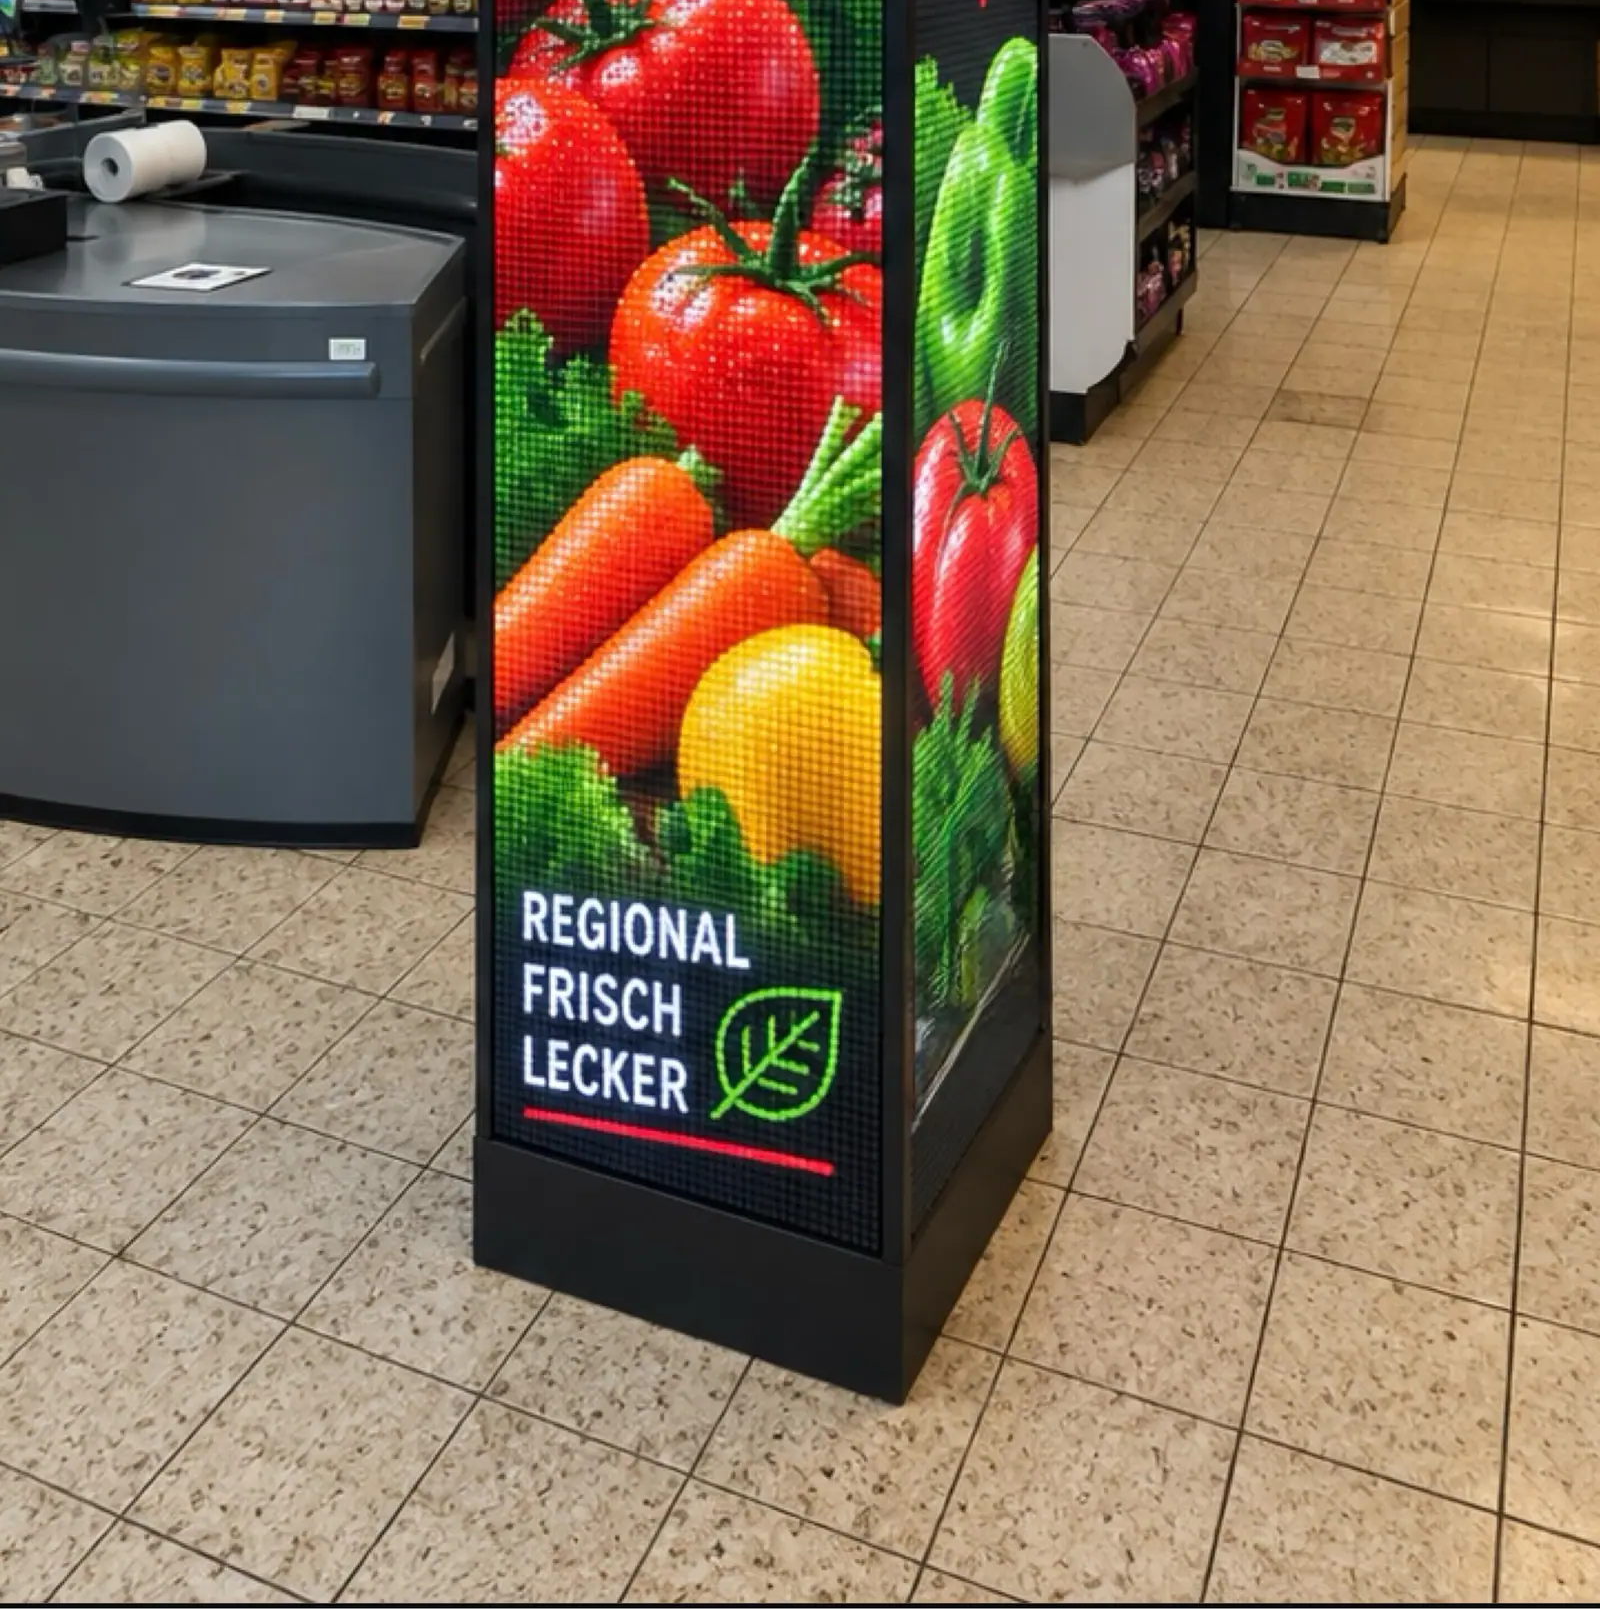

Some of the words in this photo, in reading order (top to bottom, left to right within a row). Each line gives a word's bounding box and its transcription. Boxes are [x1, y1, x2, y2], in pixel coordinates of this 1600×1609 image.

[523, 891, 751, 970] REGIONAL
[523, 962, 682, 1037] FRISCH
[523, 1035, 689, 1114] LECKER
